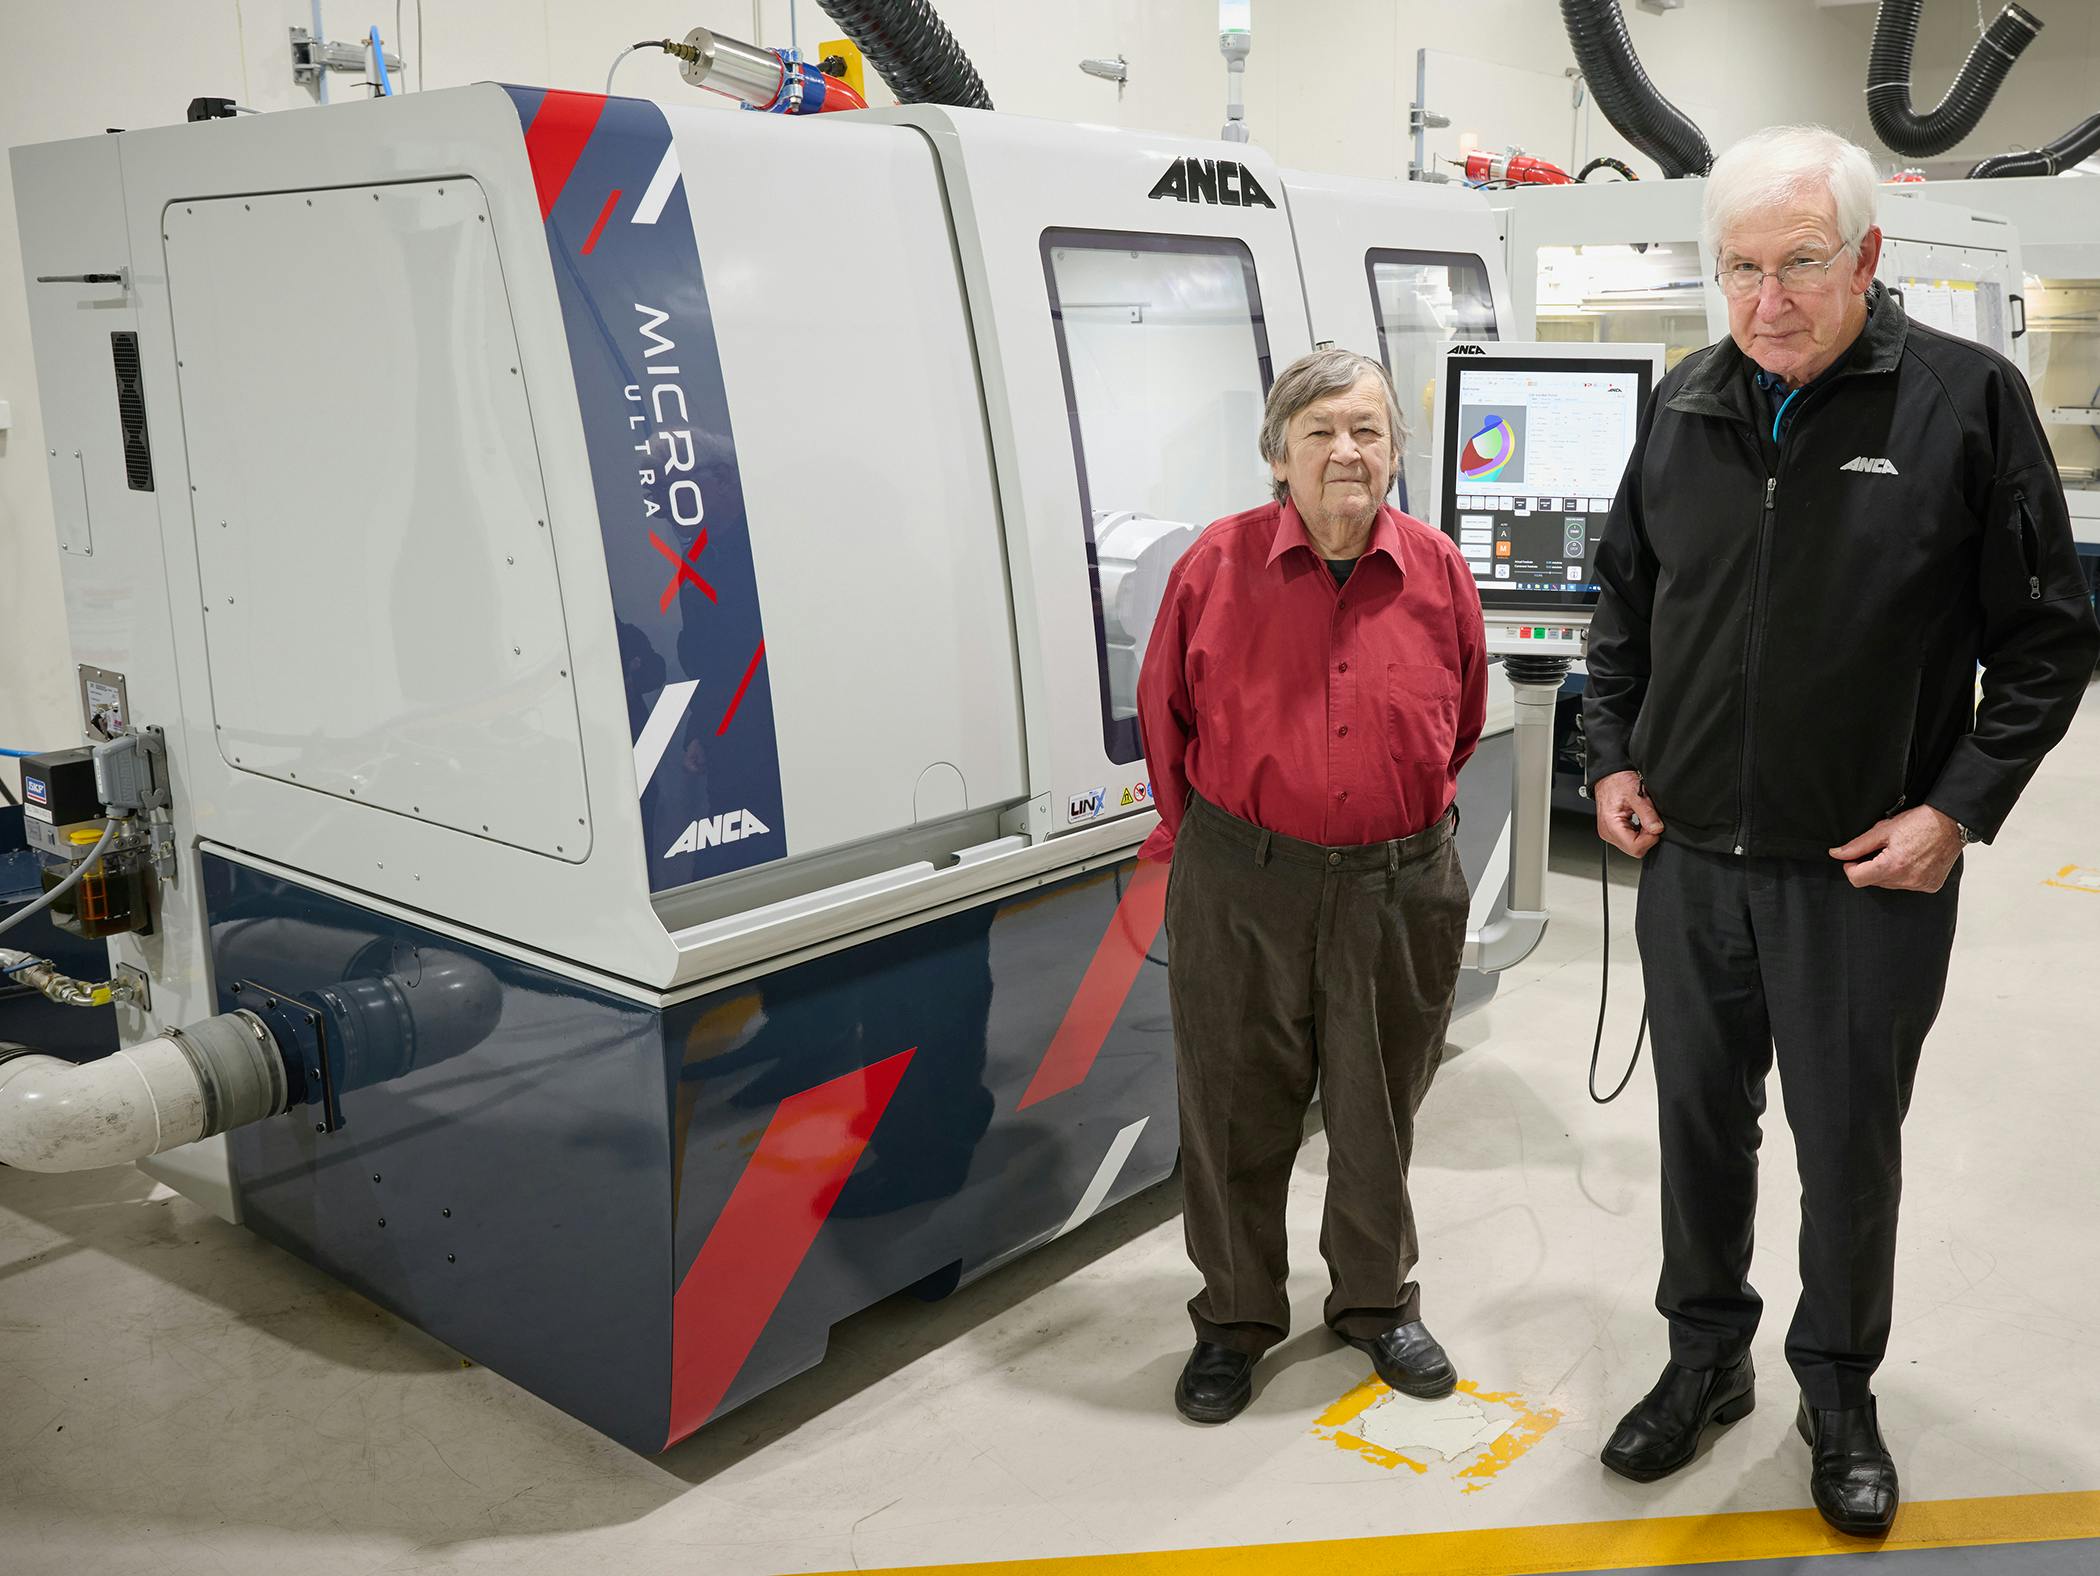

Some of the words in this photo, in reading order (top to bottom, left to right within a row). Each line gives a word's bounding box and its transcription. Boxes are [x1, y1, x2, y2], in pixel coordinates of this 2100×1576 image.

[1147, 156, 1277, 209] ANCA
[1447, 345, 1486, 355] ANCA
[634, 303, 704, 526] MICRO
[624, 384, 661, 518] ULTRA
[1839, 456, 1899, 475] ANCA
[663, 808, 770, 859] ANCA
